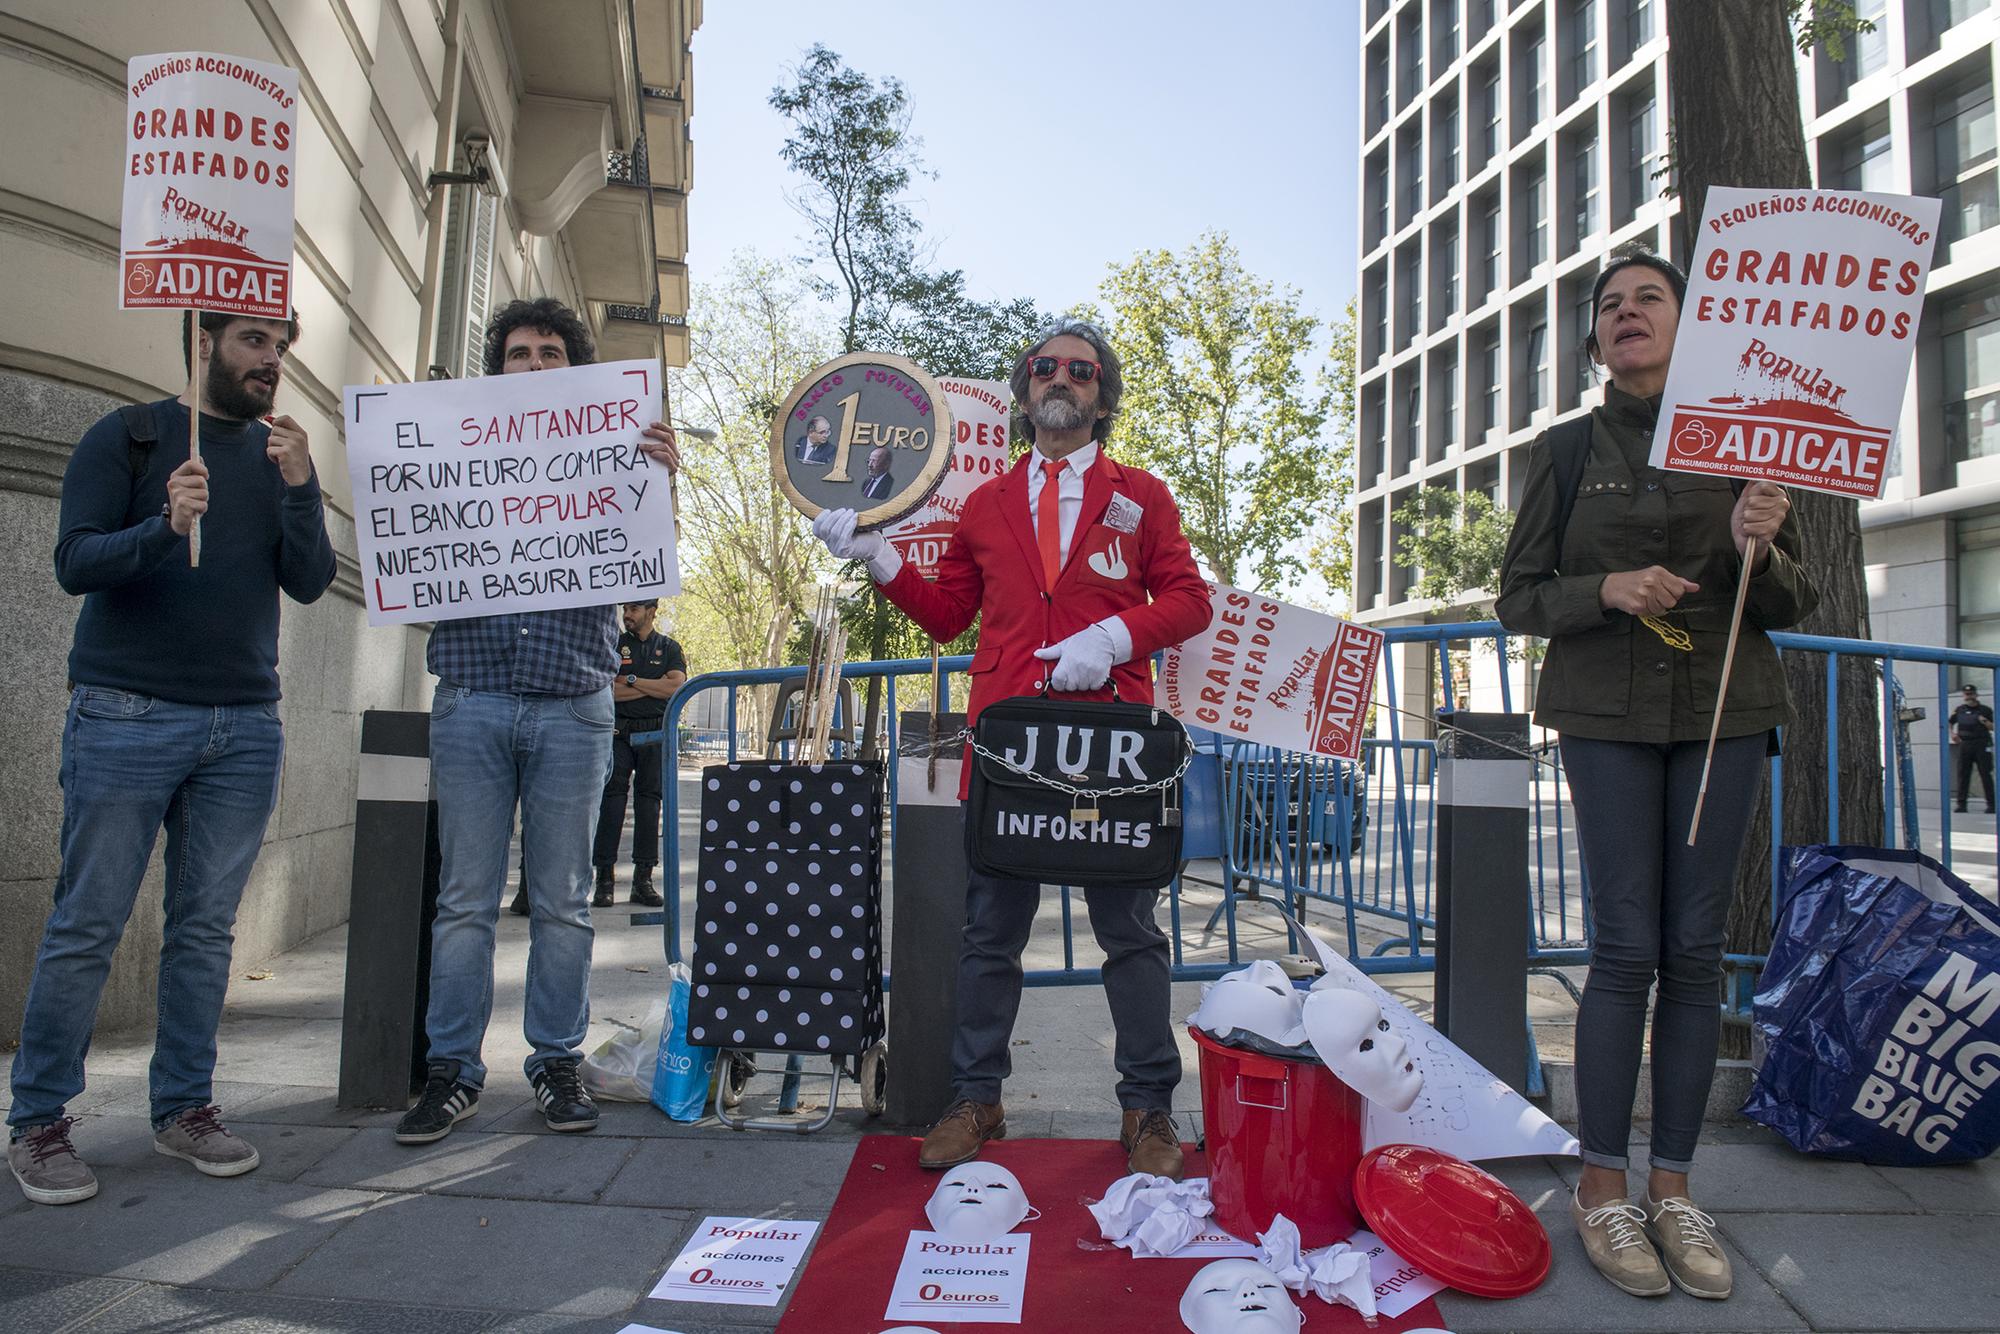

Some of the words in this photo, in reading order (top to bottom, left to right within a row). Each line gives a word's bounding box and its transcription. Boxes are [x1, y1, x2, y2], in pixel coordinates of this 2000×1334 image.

[131, 57, 192, 98] PEQUEÑOS
[195, 57, 294, 109] ACCIONISTAS
[133, 108, 290, 151] GRANDES
[131, 151, 289, 188] ESTAFADOS
[163, 186, 249, 242] Popular
[1709, 195, 1807, 234] PEQUEÑOS
[1812, 196, 1930, 247] ACCIONISTAS
[155, 263, 283, 304] ADICAE
[1705, 248, 1920, 296] GRANDES
[194, 298, 242, 310] RESPONSABLES
[248, 304, 283, 314] SOLIDARIOS
[1696, 295, 1911, 340] ESTAFADOS
[1741, 338, 1847, 403] Popular
[396, 422, 434, 449] EL
[459, 399, 640, 446] SANTANDER
[821, 391, 860, 483] 1
[852, 421, 930, 451] EURO
[371, 463, 424, 493] POR
[428, 463, 461, 489] UN
[468, 457, 537, 488] EURO
[546, 443, 650, 482] COMPRA
[1669, 457, 1728, 471] CONSUMIDORES
[1729, 465, 1765, 476] CRÍTICOS,
[1766, 468, 1823, 484] RESPONSABLES
[1824, 476, 1830, 484] Y
[1830, 478, 1874, 492] SOLIDARIOS
[1715, 424, 1883, 480] ADICAE
[371, 508, 406, 539] EL
[411, 499, 494, 534] BANCO
[502, 486, 623, 526] POPULAR
[628, 479, 649, 512] Y
[376, 540, 500, 577] NUESTRAS
[412, 582, 442, 608] EN
[448, 580, 472, 603] LA
[482, 568, 582, 600] BASURA
[589, 550, 657, 589] ESTÁN
[1195, 593, 1250, 724] GRANDES
[1229, 602, 1280, 733] ESTAFADOS
[1266, 646, 1321, 709] Popular
[1326, 629, 1372, 733] ADICAE
[1163, 654, 1185, 717] PEQUEÑOS
[1005, 725, 1148, 781] JUR
[997, 811, 1151, 848] INFORMES
[1921, 951, 2000, 1028] M
[1891, 994, 2000, 1090] BIG
[1874, 1038, 1983, 1119] BLUE
[1852, 1074, 1959, 1154] BAG
[701, 1251, 784, 1263] acciones
[708, 1226, 802, 1241] Popular
[920, 1242, 1017, 1256] Popular
[922, 1267, 1009, 1277] acciones
[1374, 1266, 1424, 1301] opula
